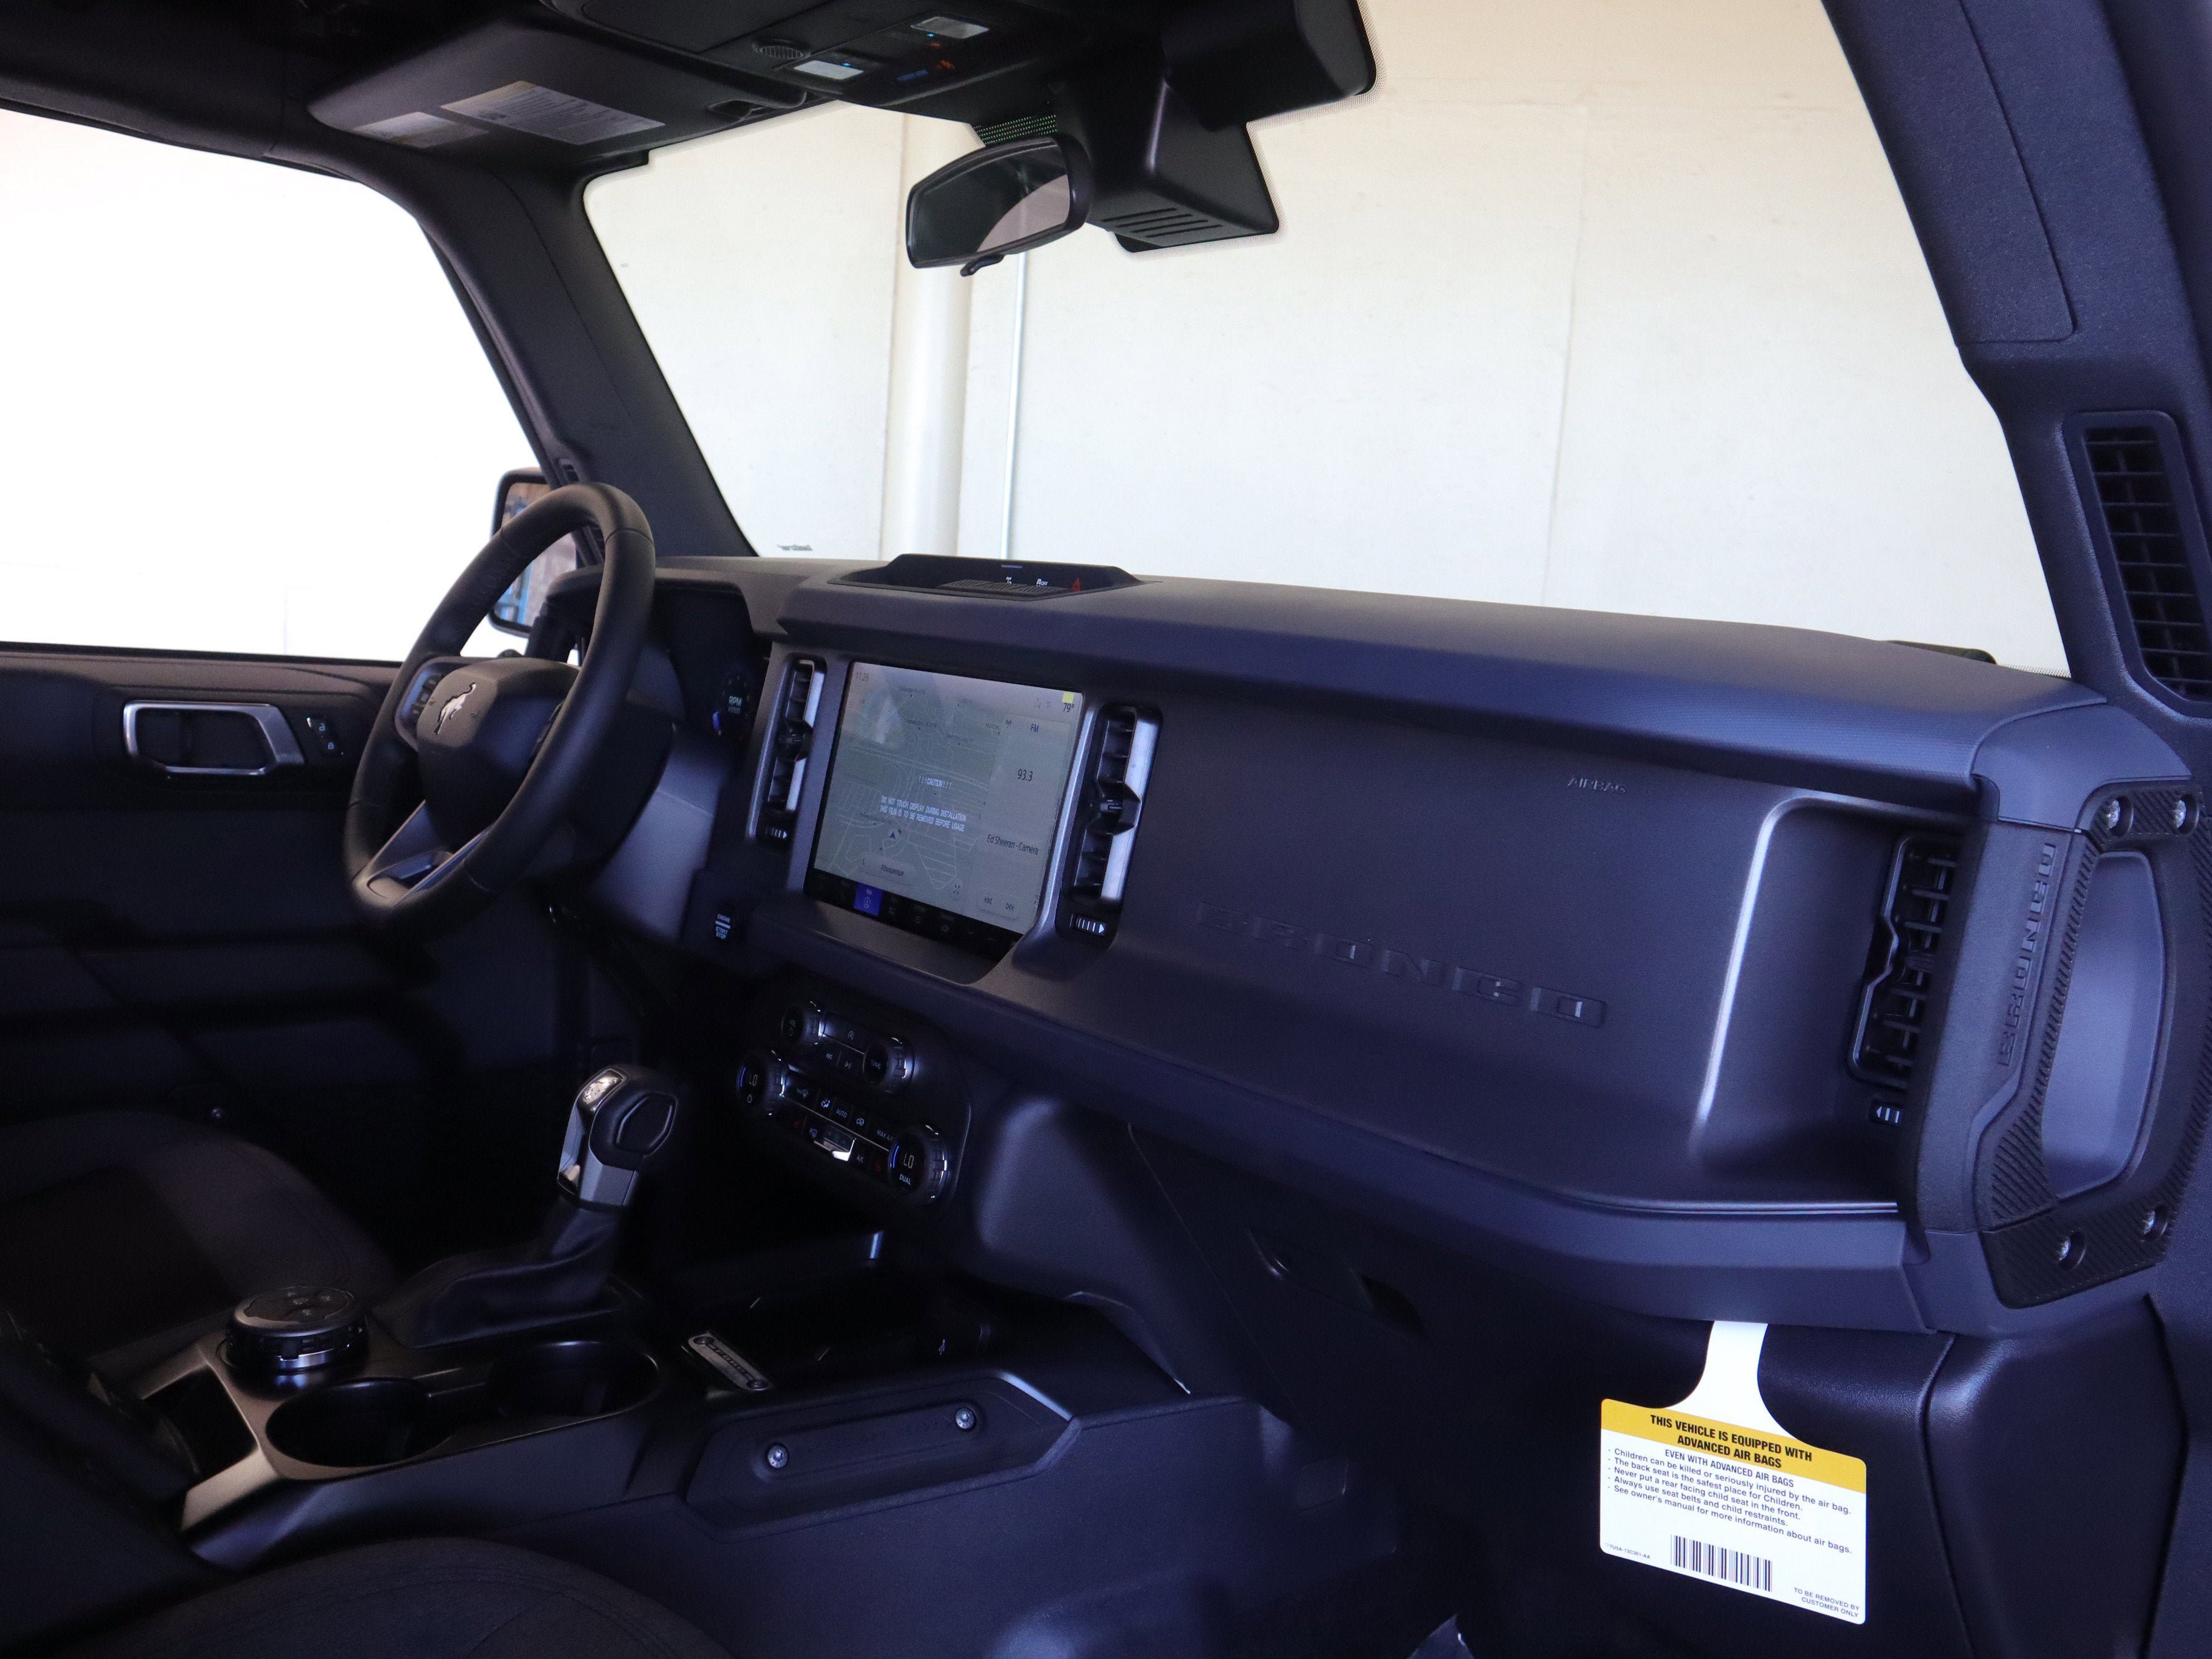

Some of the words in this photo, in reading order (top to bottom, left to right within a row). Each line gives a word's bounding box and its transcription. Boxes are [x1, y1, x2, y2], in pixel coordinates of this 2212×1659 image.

[729, 696, 742, 707] RPM
[1031, 723, 1039, 733] FM
[1017, 768, 1033, 782] 93.3
[887, 796, 896, 805] NOT
[896, 799, 909, 809] TOUCH
[909, 801, 925, 812] DISPLAY
[940, 809, 967, 822] INSTALLATION
[916, 813, 934, 825] REMOVED
[935, 818, 951, 828] BEFORE
[952, 822, 966, 832] USAGE
[987, 834, 995, 843] Ed
[995, 836, 1015, 848] Sheeran
[1018, 842, 1038, 855] Camera
[1196, 900, 1608, 1029] BRONCO
[1998, 842, 2056, 1066] BRONCO
[836, 1108, 848, 1118] AUTO
[903, 1153, 914, 1169] LO
[899, 1173, 912, 1186] DUAL
[1650, 1414, 1672, 1428] THIS
[1675, 1420, 1715, 1439] VEHICLE
[1718, 1430, 1728, 1441] IS
[1731, 1433, 1781, 1453] EQUIPPED
[1785, 1446, 1812, 1462] WITH
[1677, 1435, 1730, 1455] ADVANCED
[1733, 1448, 1751, 1461] AIR
[1754, 1453, 1781, 1468] BAGS
[1665, 1449, 1685, 1460] EVEN
[1687, 1454, 1708, 1466] WITH
[1710, 1460, 1752, 1477] ADVANCED
[1755, 1471, 1769, 1482] AIR
[1772, 1475, 1794, 1487] BAGS
[1614, 1448, 1647, 1462] Children
[1650, 1458, 1664, 1466] can
[1667, 1461, 1677, 1469] be
[1680, 1463, 1701, 1475] killed
[1715, 1474, 1753, 1490] seriously
[1756, 1483, 1786, 1496] injured
[1789, 1491, 1799, 1501] by
[1802, 1495, 1815, 1504] the
[1832, 1503, 1850, 1515] bag.
[1614, 1457, 1628, 1467] The
[1631, 1462, 1650, 1472] back
[1653, 1468, 1669, 1477] seat
[1681, 1474, 1694, 1483] the
[1696, 1478, 1721, 1490] safest
[1724, 1485, 1746, 1496] place
[1749, 1490, 1761, 1500] for
[1764, 1494, 1802, 1510] Children.
[1614, 1466, 1637, 1478] Never
[1640, 1474, 1652, 1482] put
[1662, 1480, 1678, 1488] rear
[1680, 1483, 1705, 1496] facing
[1708, 1491, 1728, 1501] child
[1731, 1497, 1748, 1506] seat
[1751, 1501, 1759, 1509] in
[1761, 1503, 1775, 1513] the
[1777, 1507, 1800, 1520] front.
[1614, 1476, 1642, 1488] Always
[1645, 1485, 1659, 1493] use
[1661, 1489, 1678, 1498] seat
[1681, 1492, 1701, 1503] belts
[1703, 1500, 1719, 1508] and
[1721, 1504, 1742, 1514] child
[1745, 1510, 1787, 1526] restraints.
[1614, 1485, 1628, 1494] See
[1631, 1490, 1662, 1503] owner's
[1665, 1499, 1694, 1511] manual
[1697, 1506, 1708, 1515] for
[1711, 1511, 1732, 1521] more
[1735, 1516, 1784, 1534] information
[1787, 1531, 1811, 1542] about
[1828, 1541, 1851, 1553] bags.
[1794, 1587, 1803, 1595] TO
[1815, 1594, 1849, 1608] REMOVED
[1801, 1597, 1839, 1612] CUSTOMER
[1840, 1608, 1859, 1618] ONLY
